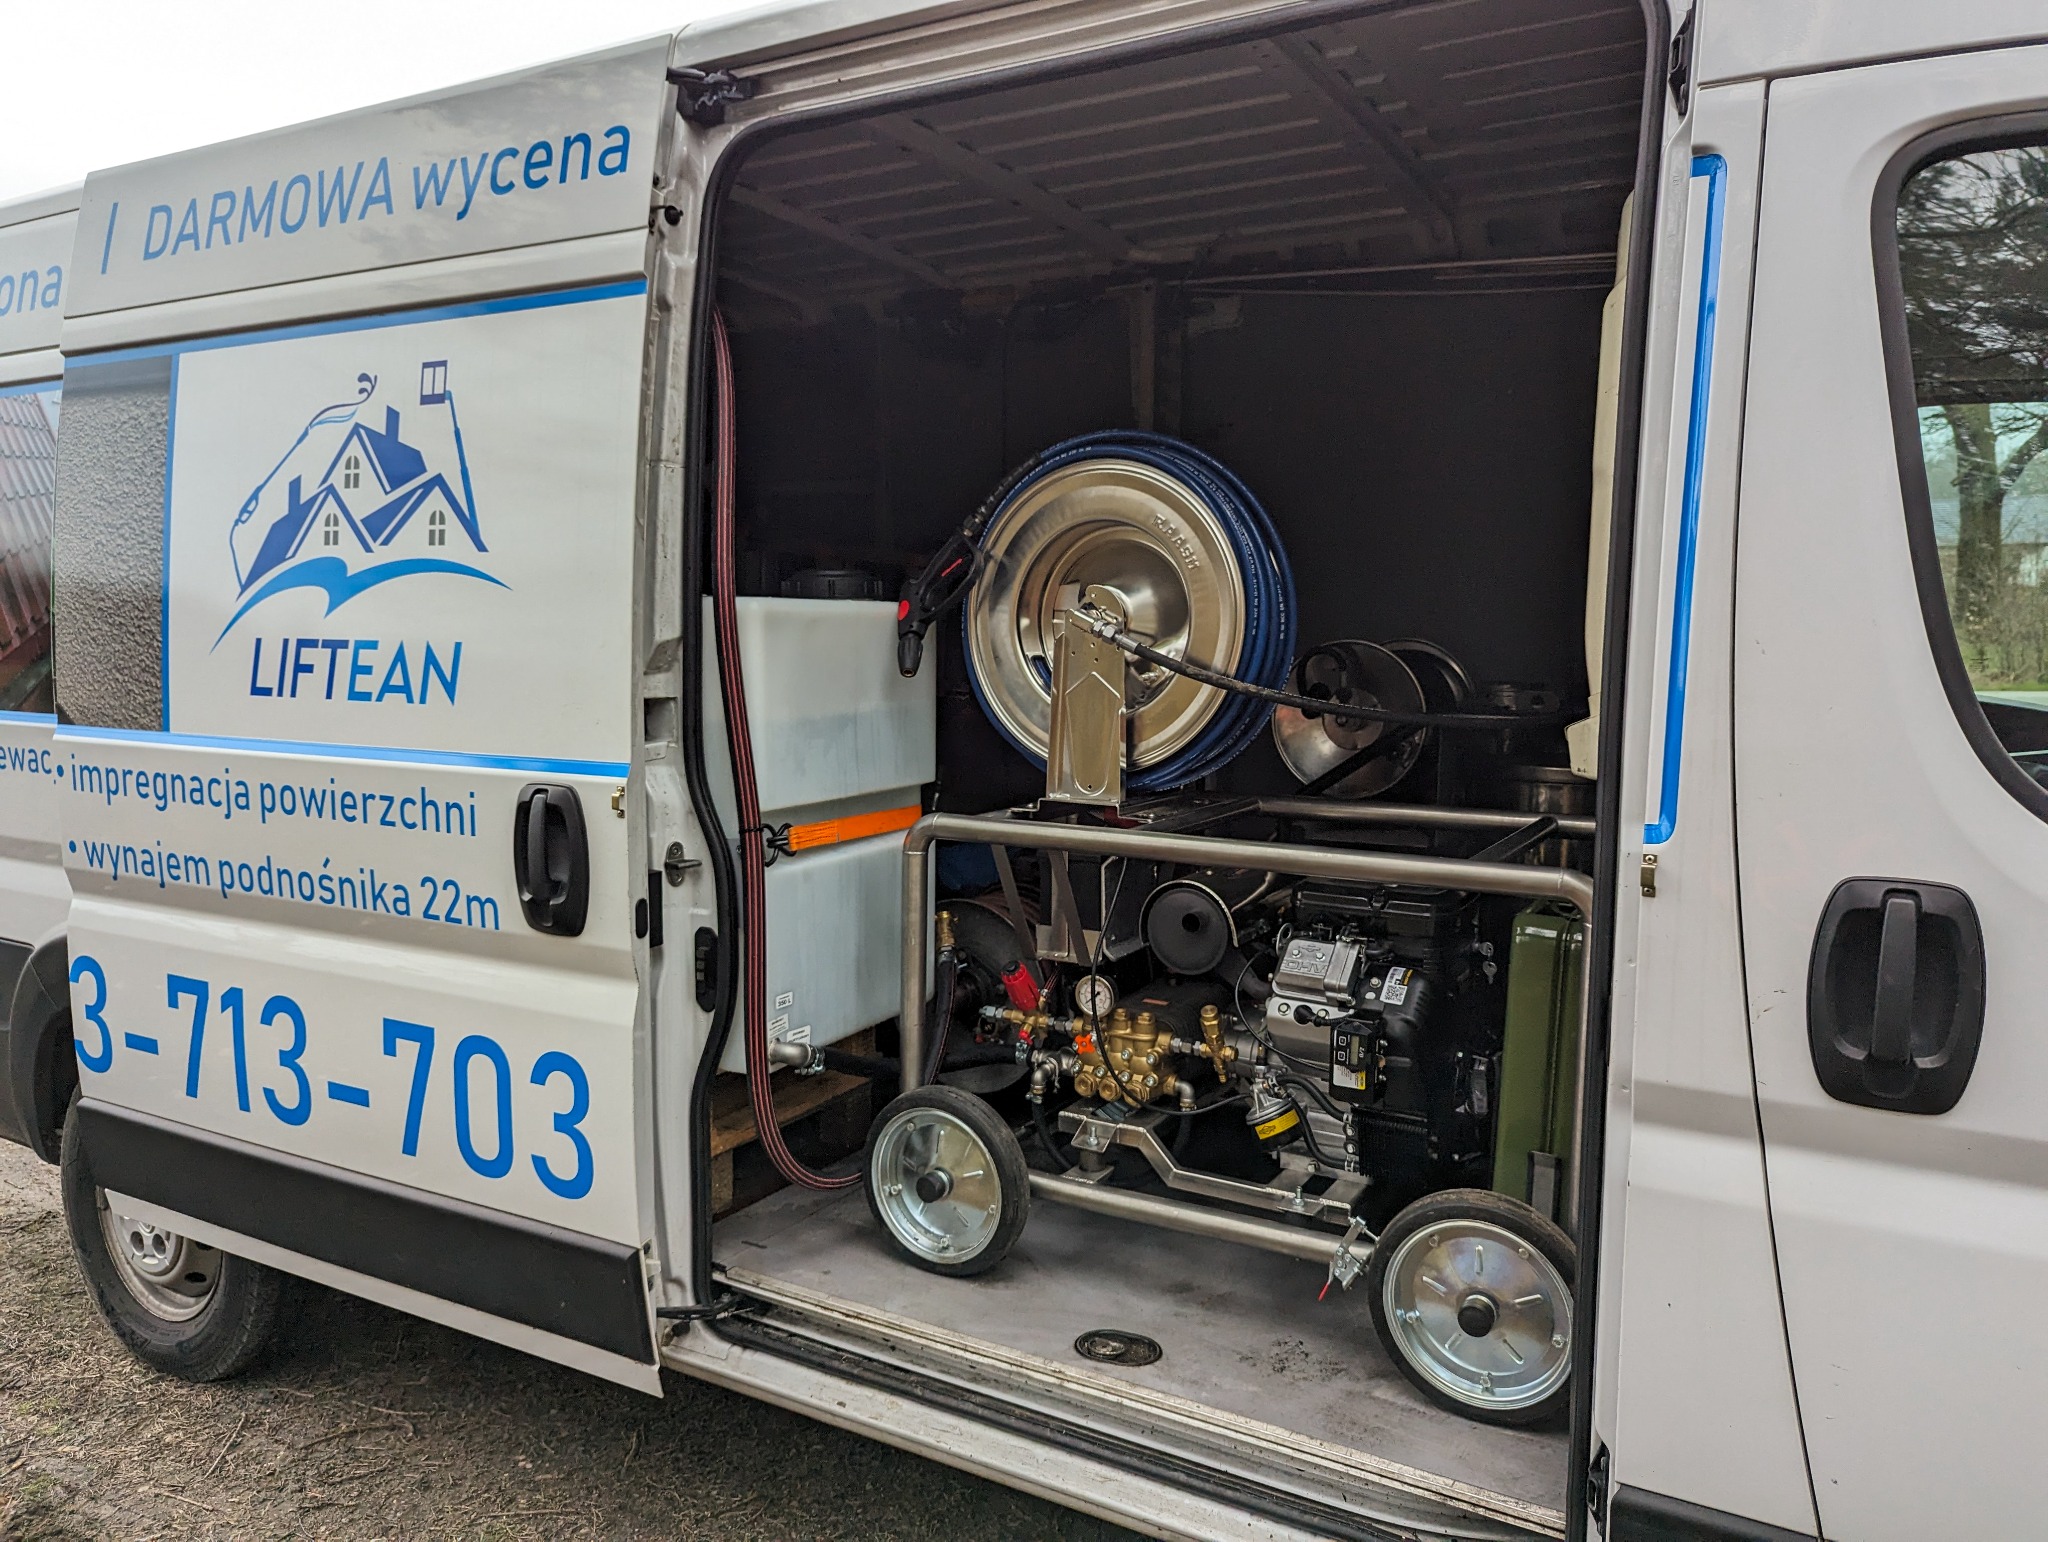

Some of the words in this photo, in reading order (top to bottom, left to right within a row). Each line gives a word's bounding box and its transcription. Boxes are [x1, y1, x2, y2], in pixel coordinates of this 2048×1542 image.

[143, 156, 395, 261] DARMOWA
[413, 124, 632, 221] wycena
[249, 637, 463, 706] LIFTEAN
[0, 745, 56, 785] ewac
[71, 753, 251, 820] impregnacja
[259, 778, 477, 838] powierzchni
[83, 839, 211, 889] wynajem
[218, 856, 411, 917] podnośnika
[420, 875, 500, 931] 22m
